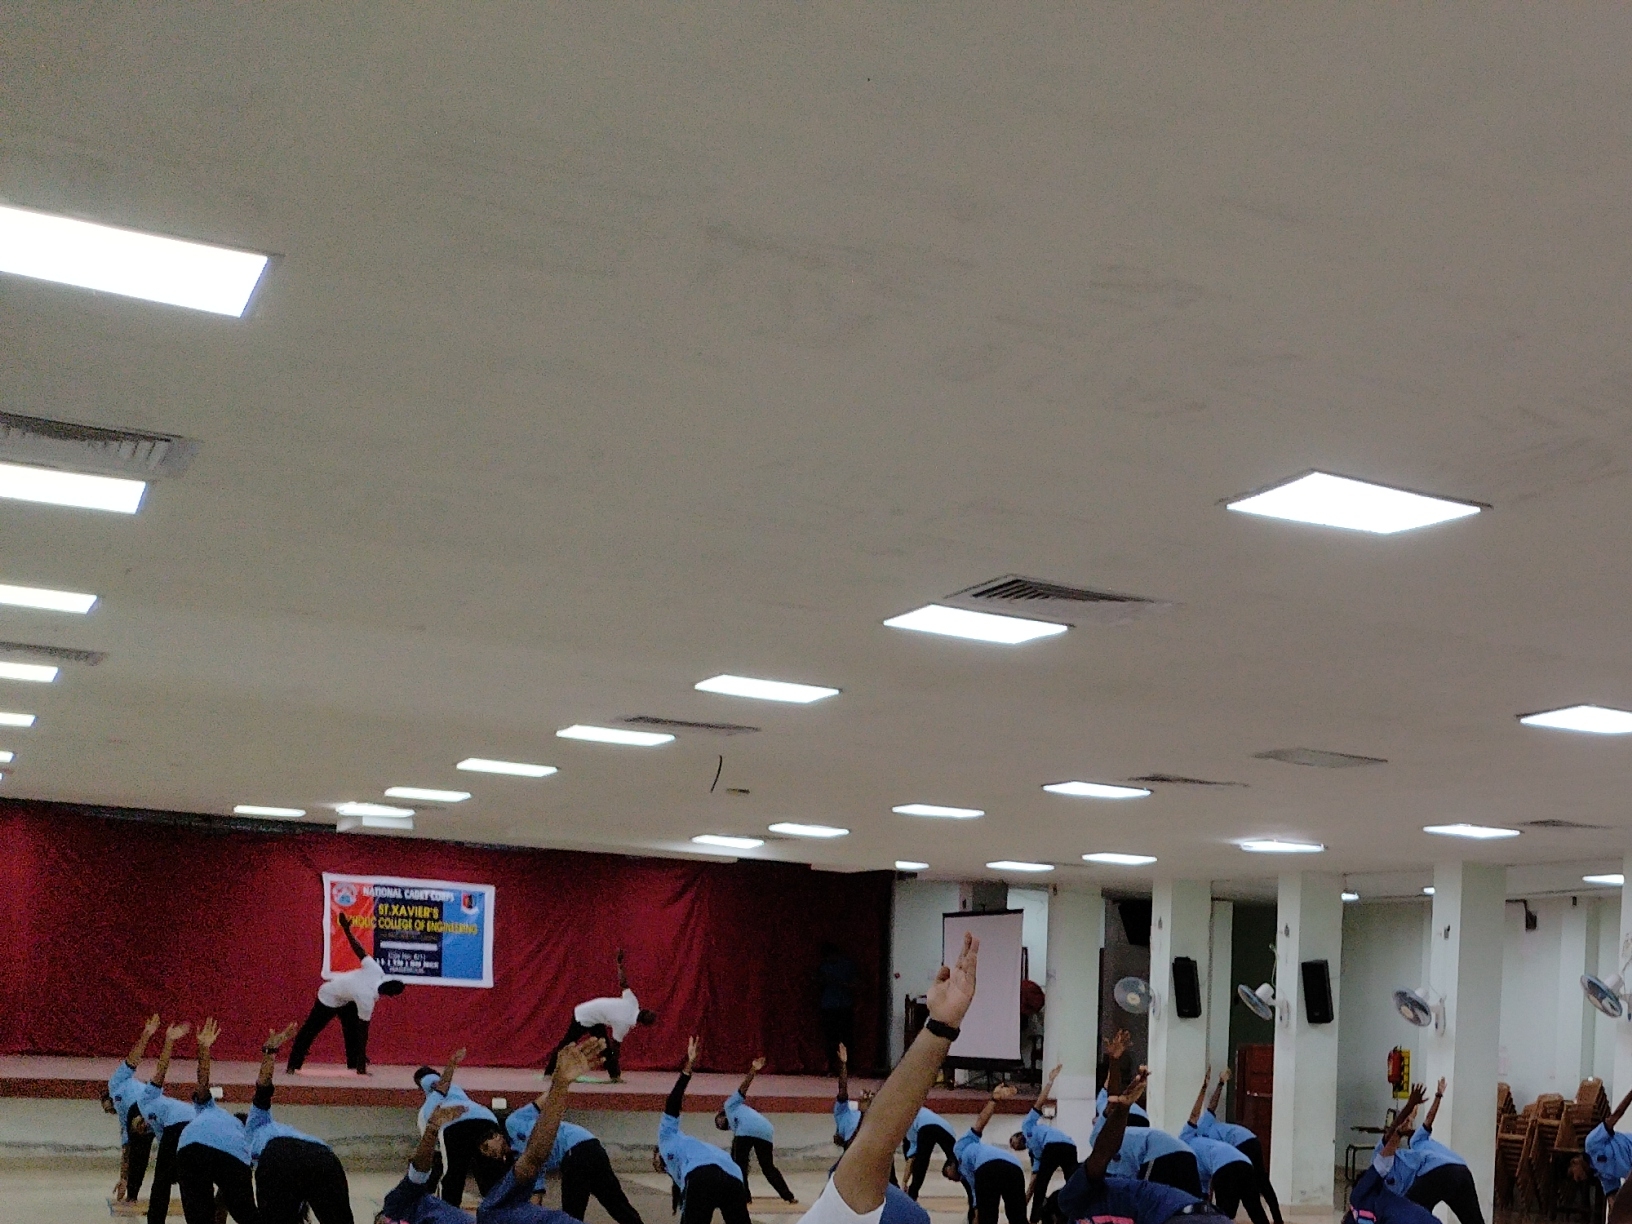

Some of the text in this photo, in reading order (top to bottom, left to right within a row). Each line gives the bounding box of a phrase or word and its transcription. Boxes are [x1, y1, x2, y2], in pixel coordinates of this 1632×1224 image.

[363, 886, 455, 902] NATIONAL CADET CORPS
[378, 917, 413, 930] COLLEGE
[414, 920, 425, 932] OF
[426, 920, 478, 935] ENGINEERING
